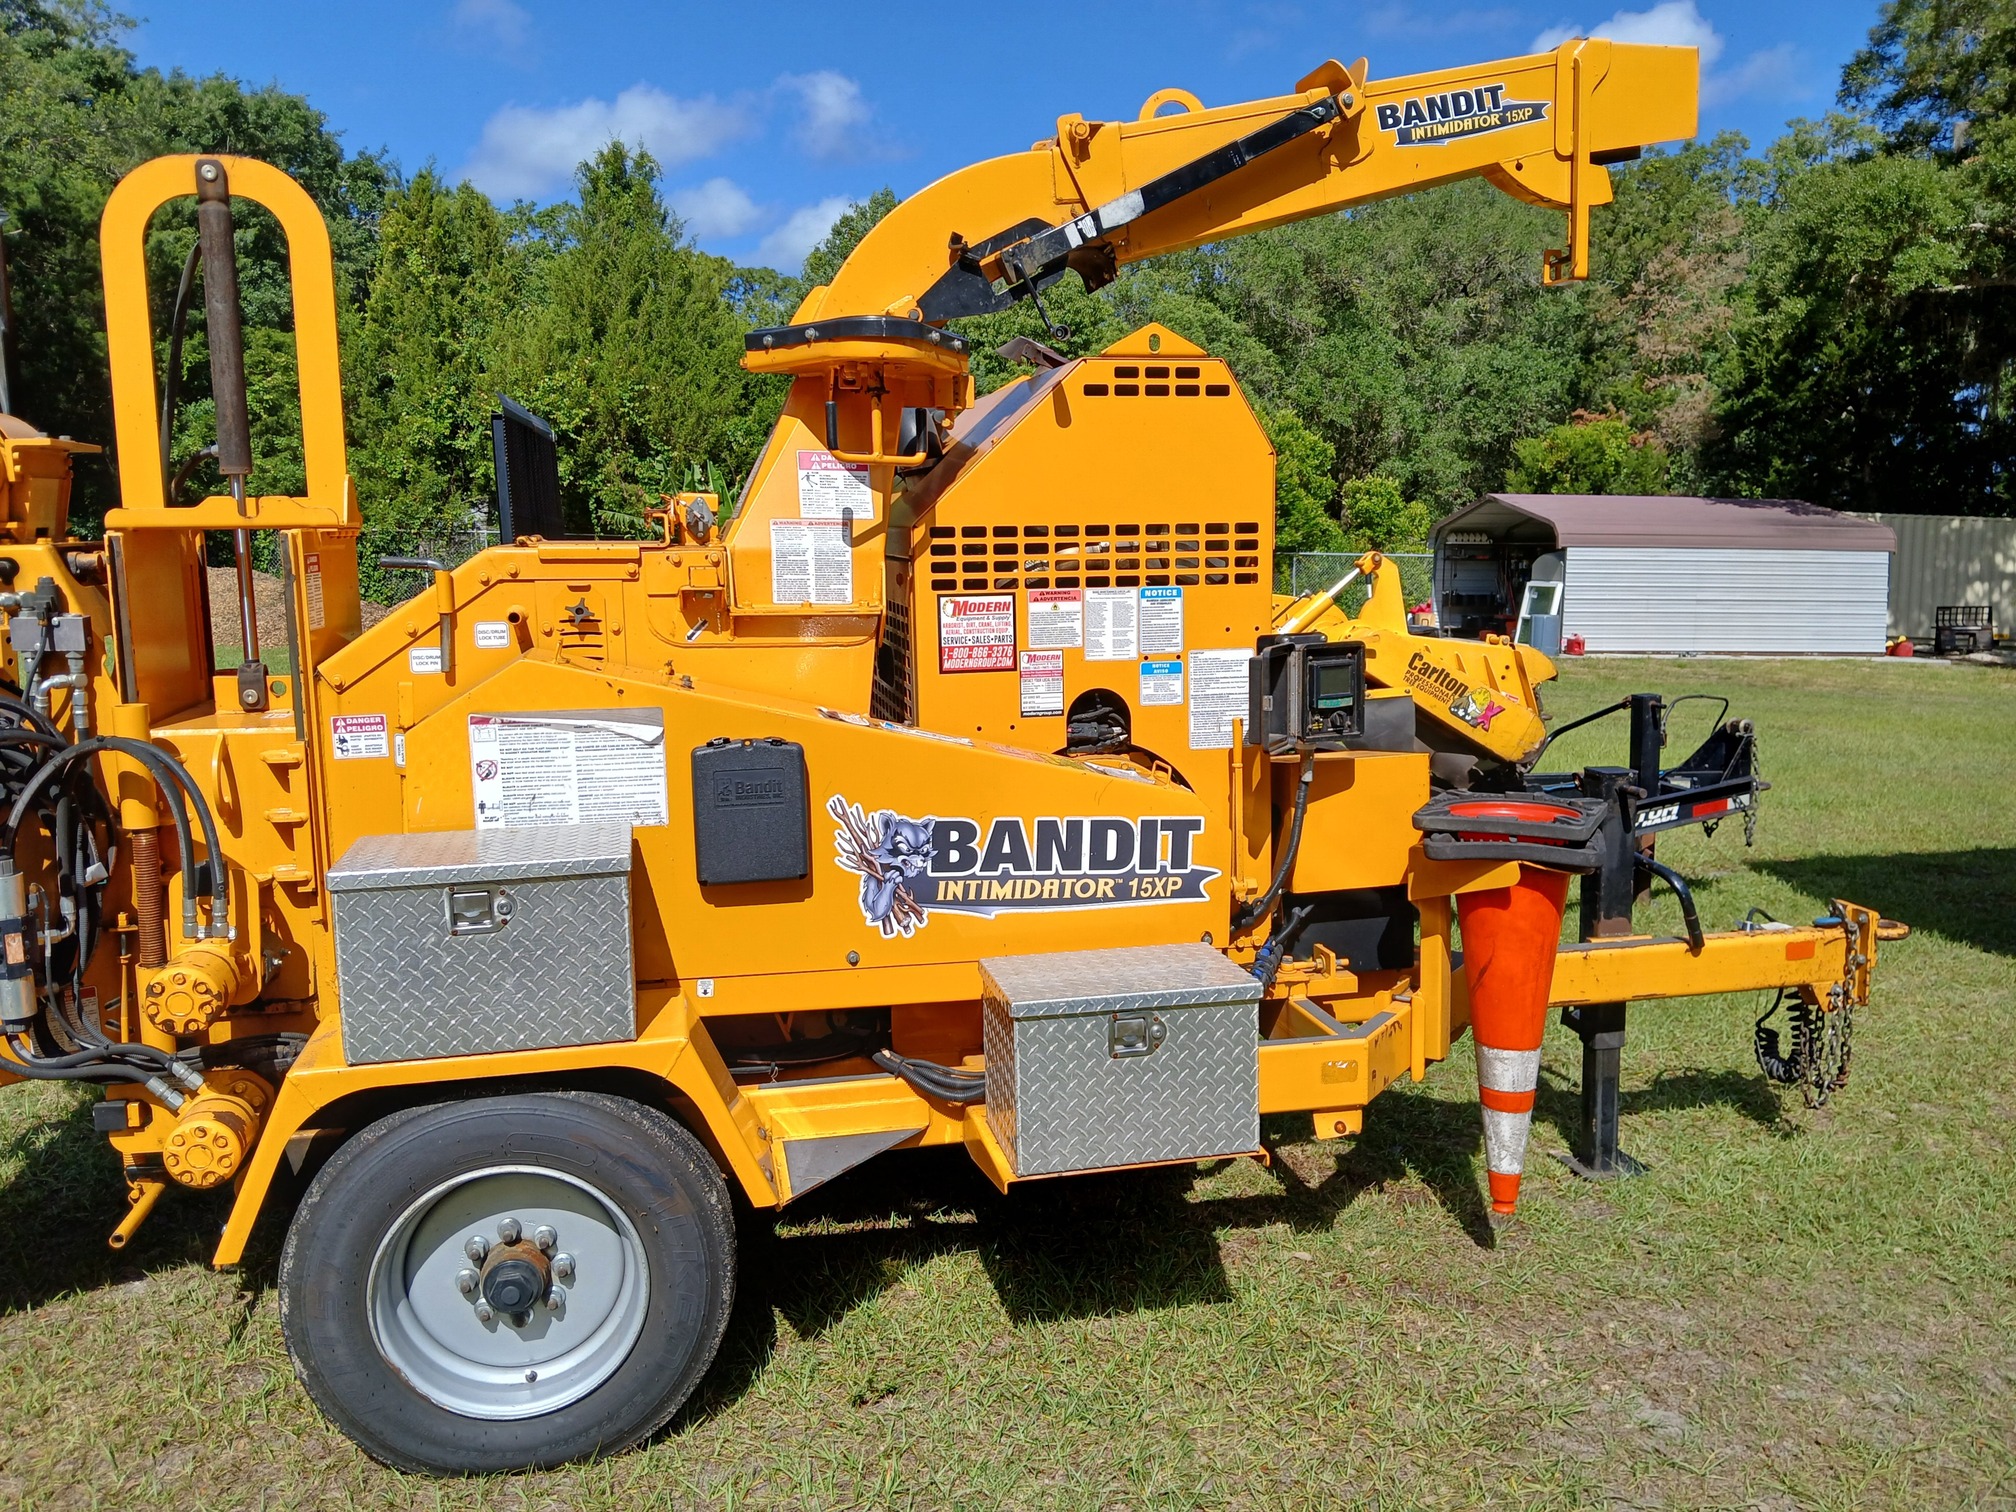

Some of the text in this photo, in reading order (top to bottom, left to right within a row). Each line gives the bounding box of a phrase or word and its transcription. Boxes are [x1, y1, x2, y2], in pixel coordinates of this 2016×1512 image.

[1378, 85, 1504, 130] BANDIT
[1505, 107, 1533, 123] 15XP
[1145, 589, 1178, 597] NOTICE
[952, 600, 1011, 617] MODERN
[991, 614, 1011, 622] Supply
[943, 646, 1013, 659] 1-800-866-3376
[1027, 653, 1061, 664] MODERN
[943, 656, 1013, 669] MODERNGROUP.COM
[1407, 652, 1469, 698] Carlton
[1405, 669, 1455, 700] PROFESSIONAL
[1416, 682, 1451, 705] EQUIPMENT
[346, 716, 382, 724] DANGER
[346, 724, 383, 732] PELIGRO
[735, 779, 783, 795] Bandit
[930, 819, 1202, 874] BANDIT
[1128, 876, 1183, 898] 15XP
